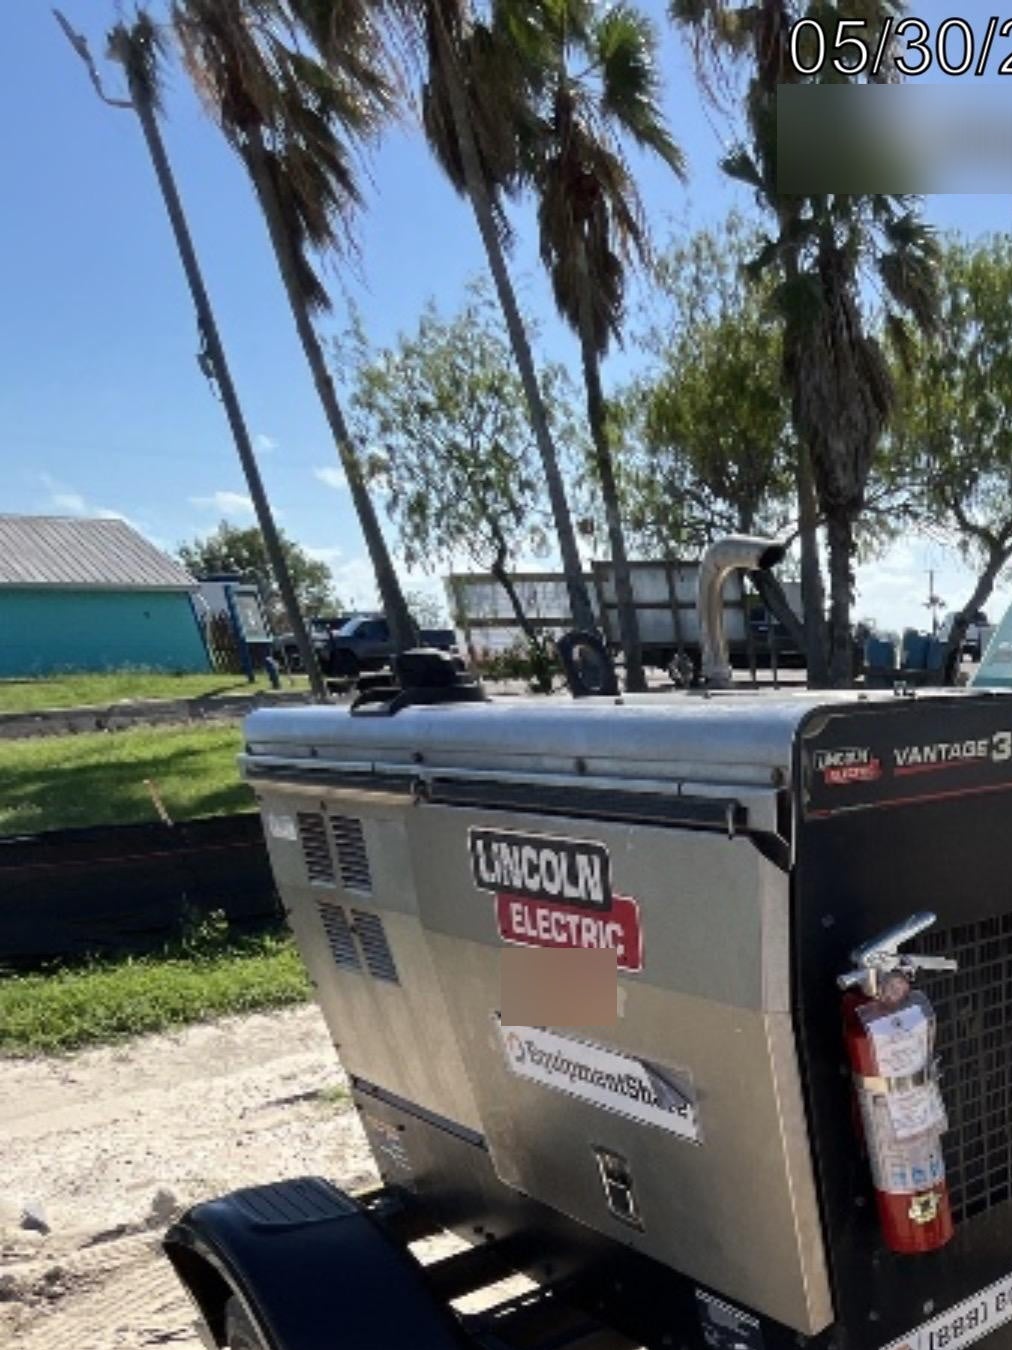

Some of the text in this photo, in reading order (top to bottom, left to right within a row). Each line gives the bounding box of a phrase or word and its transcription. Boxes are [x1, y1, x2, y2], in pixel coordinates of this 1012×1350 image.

[893, 738, 988, 767] VANTAGE
[475, 839, 605, 903] LINCOLN
[509, 901, 626, 957] ELECTRIC
